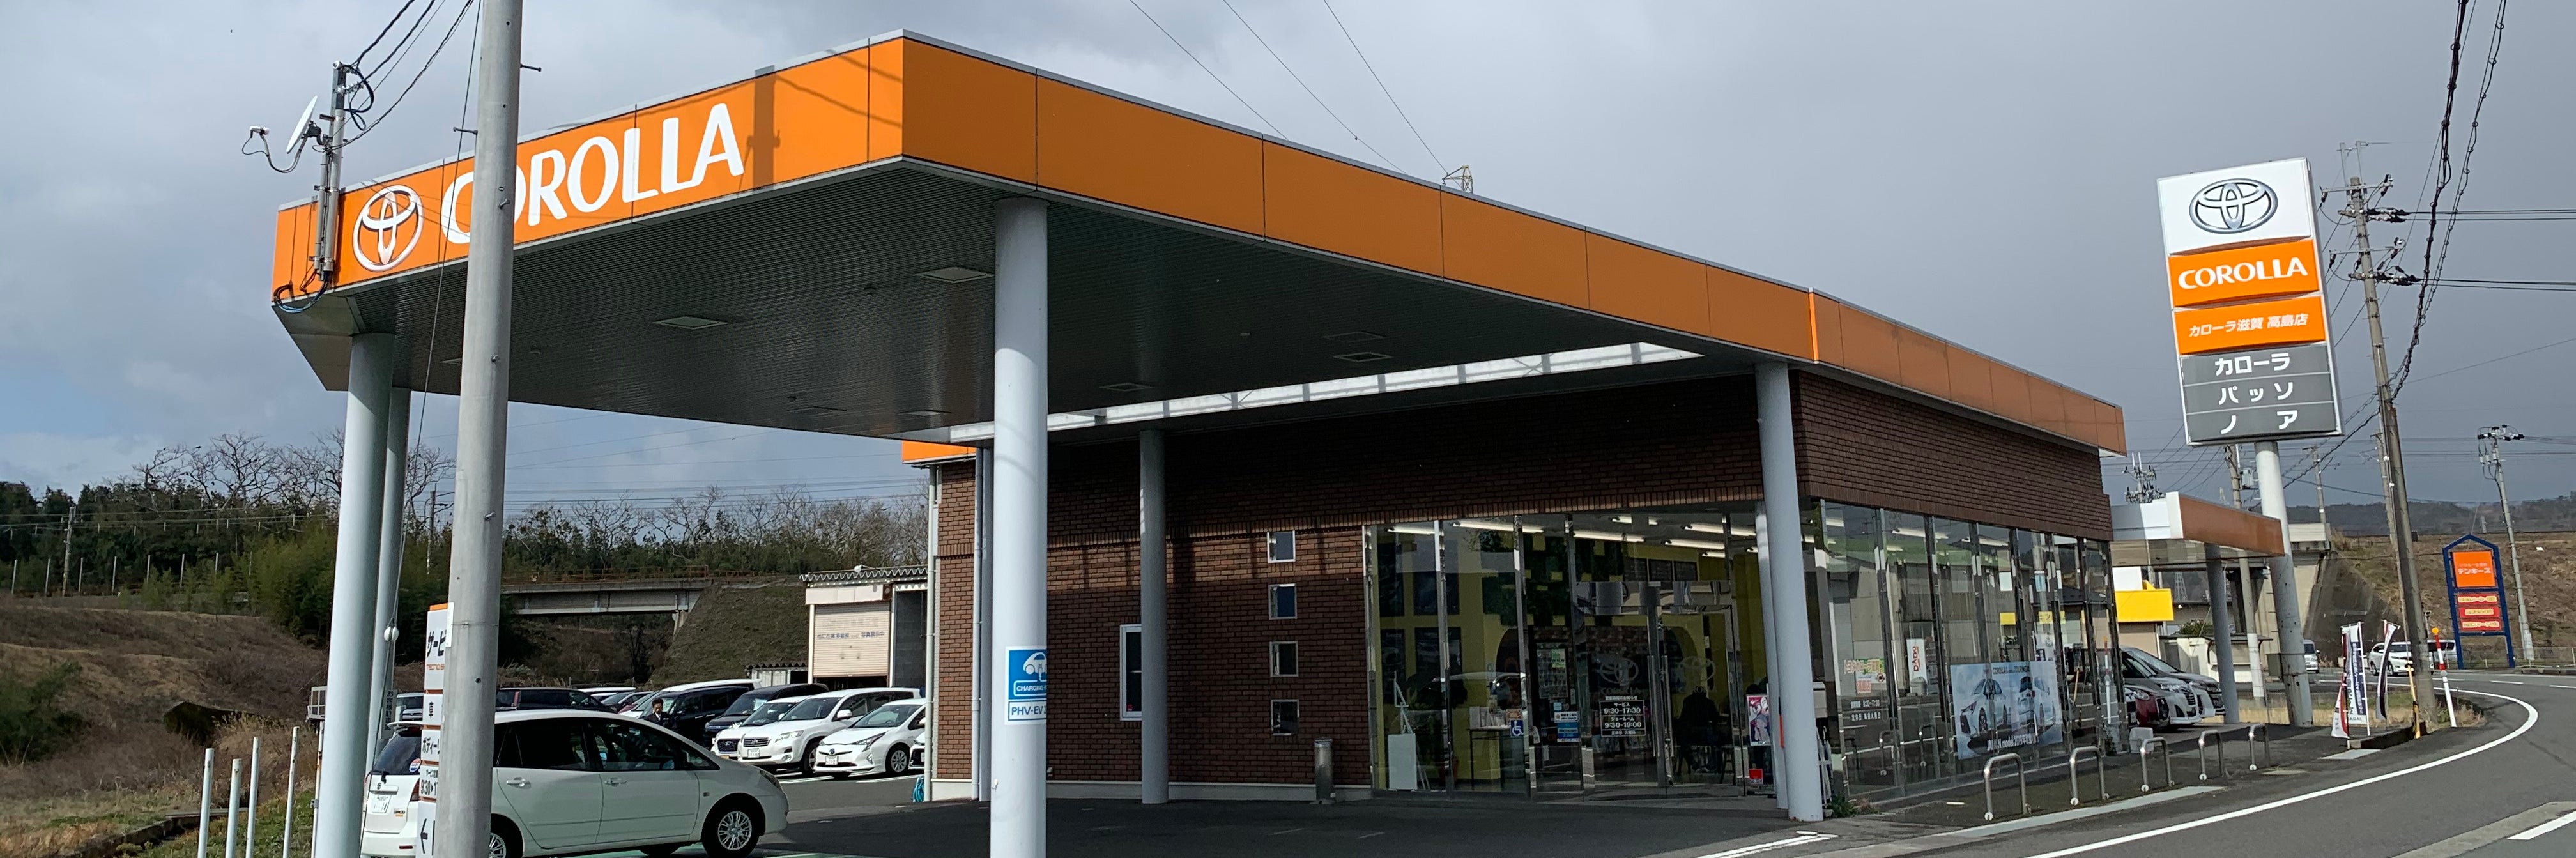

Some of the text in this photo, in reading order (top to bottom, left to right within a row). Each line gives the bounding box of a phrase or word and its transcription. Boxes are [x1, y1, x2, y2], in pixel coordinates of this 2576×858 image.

[441, 103, 744, 245] CROLLA
[2178, 257, 2308, 289] COROLLA
[2189, 313, 2309, 337] カローラ滋賀 高島店
[2214, 353, 2290, 376] カローラ
[2219, 382, 2294, 405] パッソ
[427, 629, 447, 658] サービ
